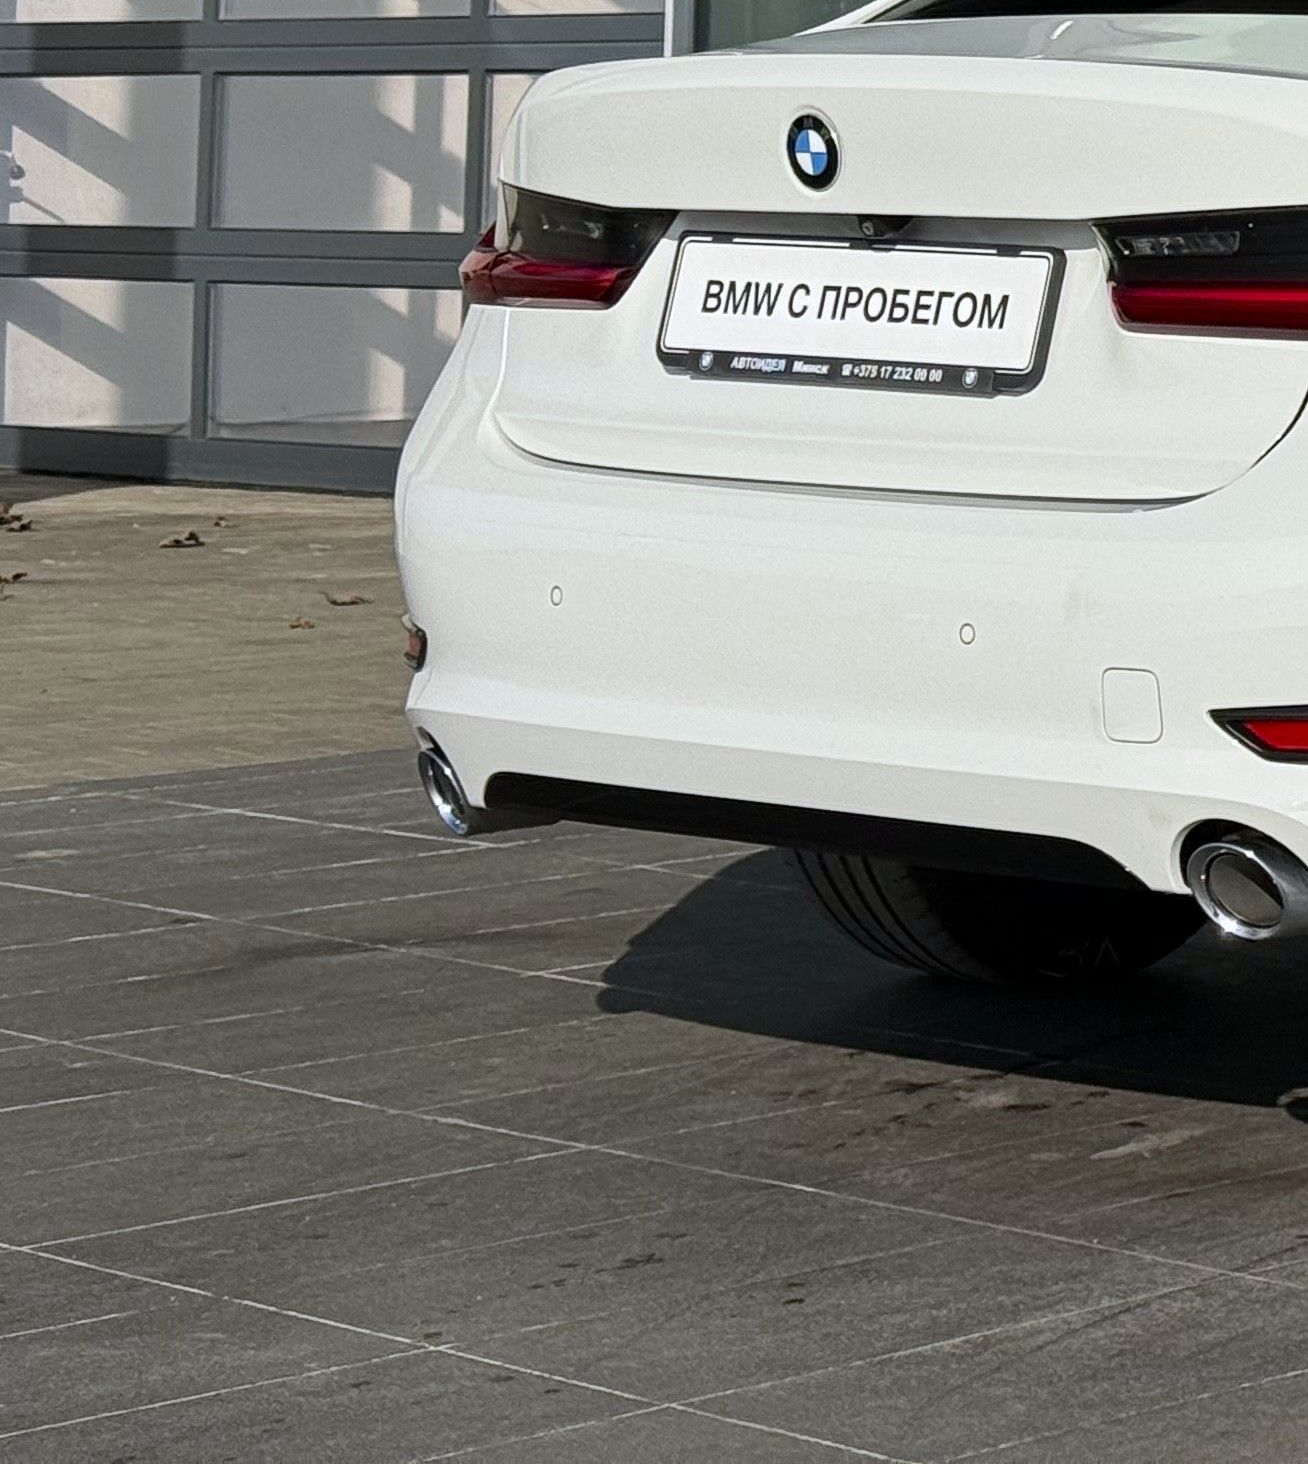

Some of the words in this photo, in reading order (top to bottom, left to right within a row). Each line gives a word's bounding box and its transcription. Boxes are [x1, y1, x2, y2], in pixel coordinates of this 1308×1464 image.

[701, 280, 784, 316] BMW
[788, 284, 810, 318] С
[817, 286, 1010, 329] ПРОБЕГОМ
[880, 366, 893, 379] 17
[893, 367, 913, 380] 232
